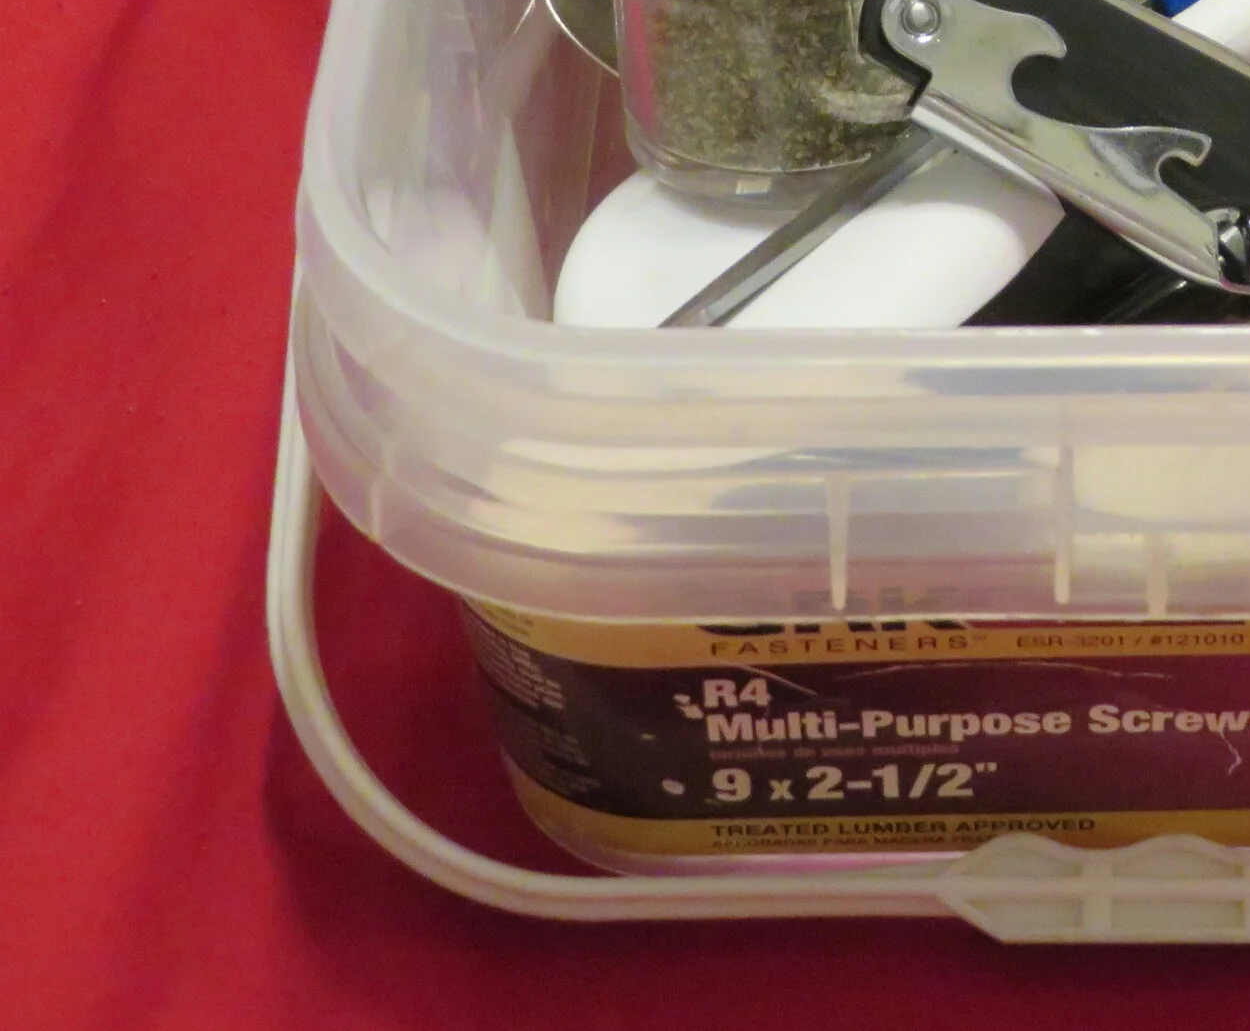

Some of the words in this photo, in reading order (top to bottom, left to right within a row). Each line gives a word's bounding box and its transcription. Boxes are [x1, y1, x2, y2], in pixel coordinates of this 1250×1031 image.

[709, 635, 969, 657] FASTENERS
[702, 678, 772, 708] R4
[705, 708, 1072, 743] Multi-Purpose
[711, 767, 752, 802] 9
[769, 778, 795, 801] x
[805, 761, 998, 800] 2-1/2"
[711, 823, 830, 838] TREATED
[838, 820, 948, 836] LUMBER
[956, 817, 1097, 834] APPROVED
